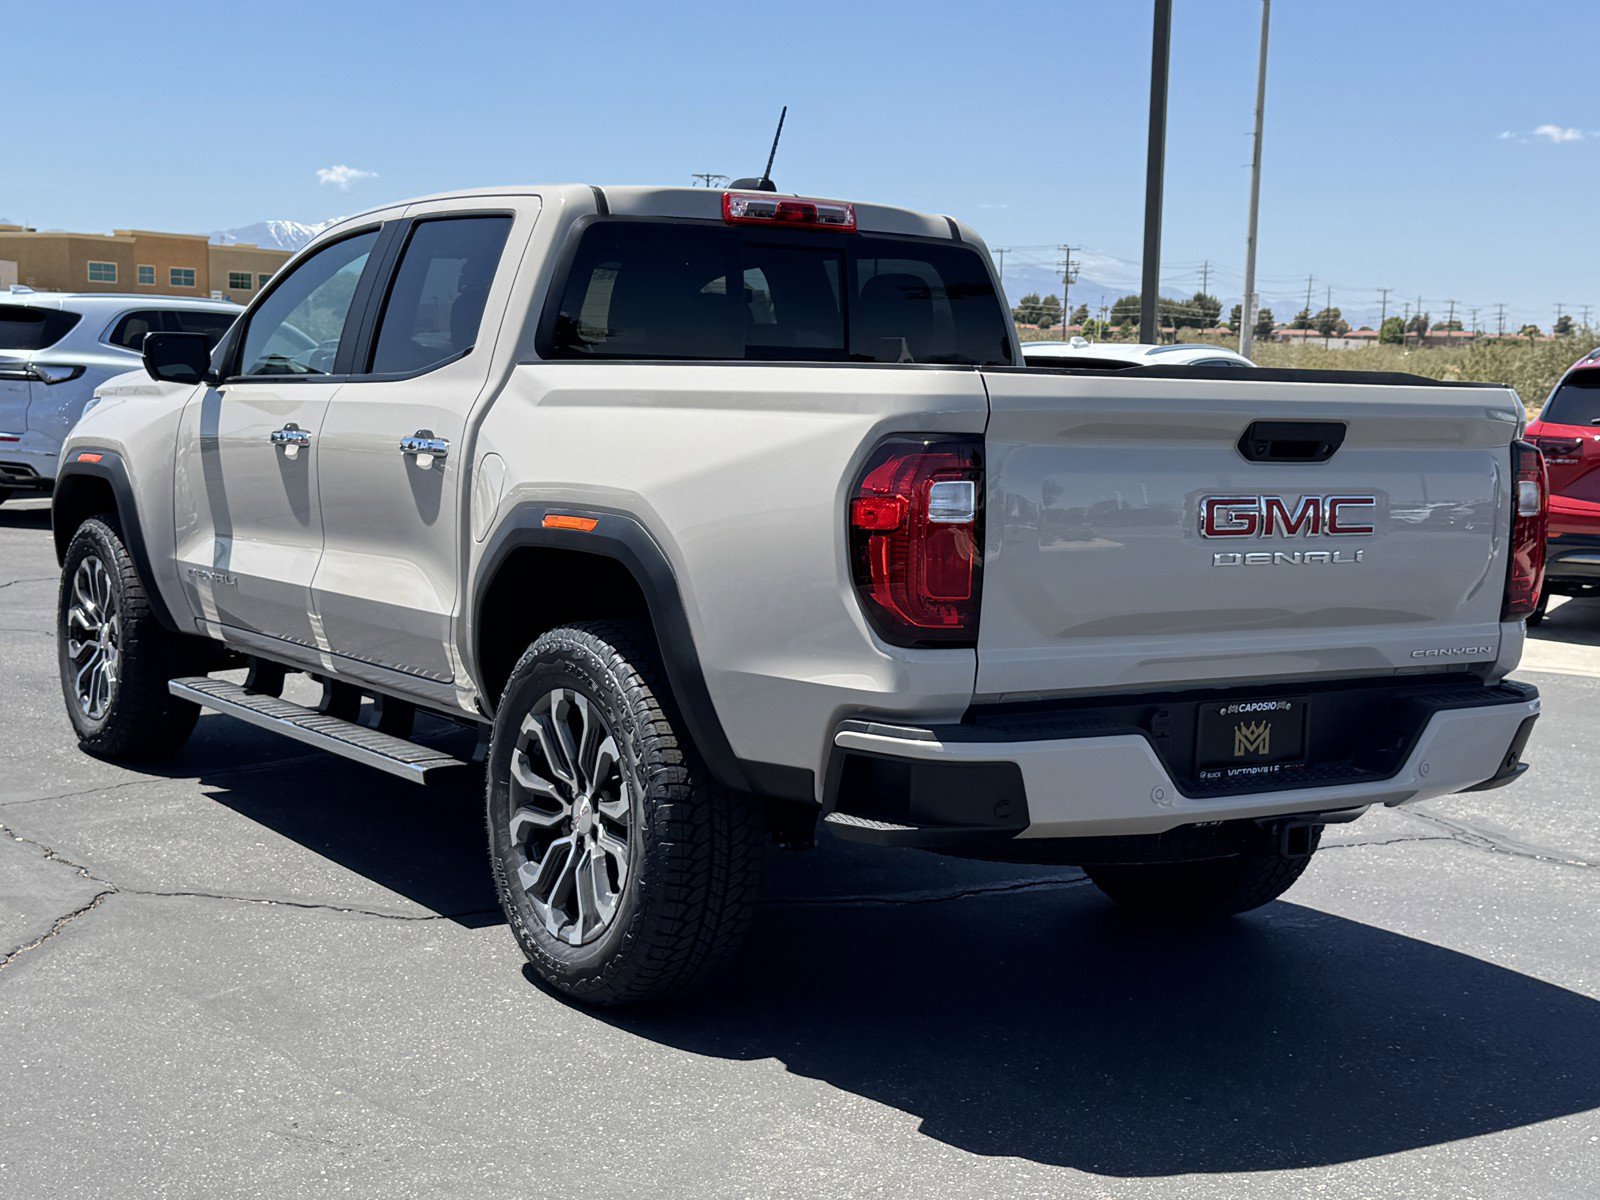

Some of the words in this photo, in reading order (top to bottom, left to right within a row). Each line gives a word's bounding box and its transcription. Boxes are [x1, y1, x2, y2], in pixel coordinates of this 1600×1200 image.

[1201, 495, 1376, 539] GMC
[1213, 550, 1363, 567] DENALI
[1411, 646, 1492, 658] CANYON
[1239, 701, 1277, 713] CAPOSIO
